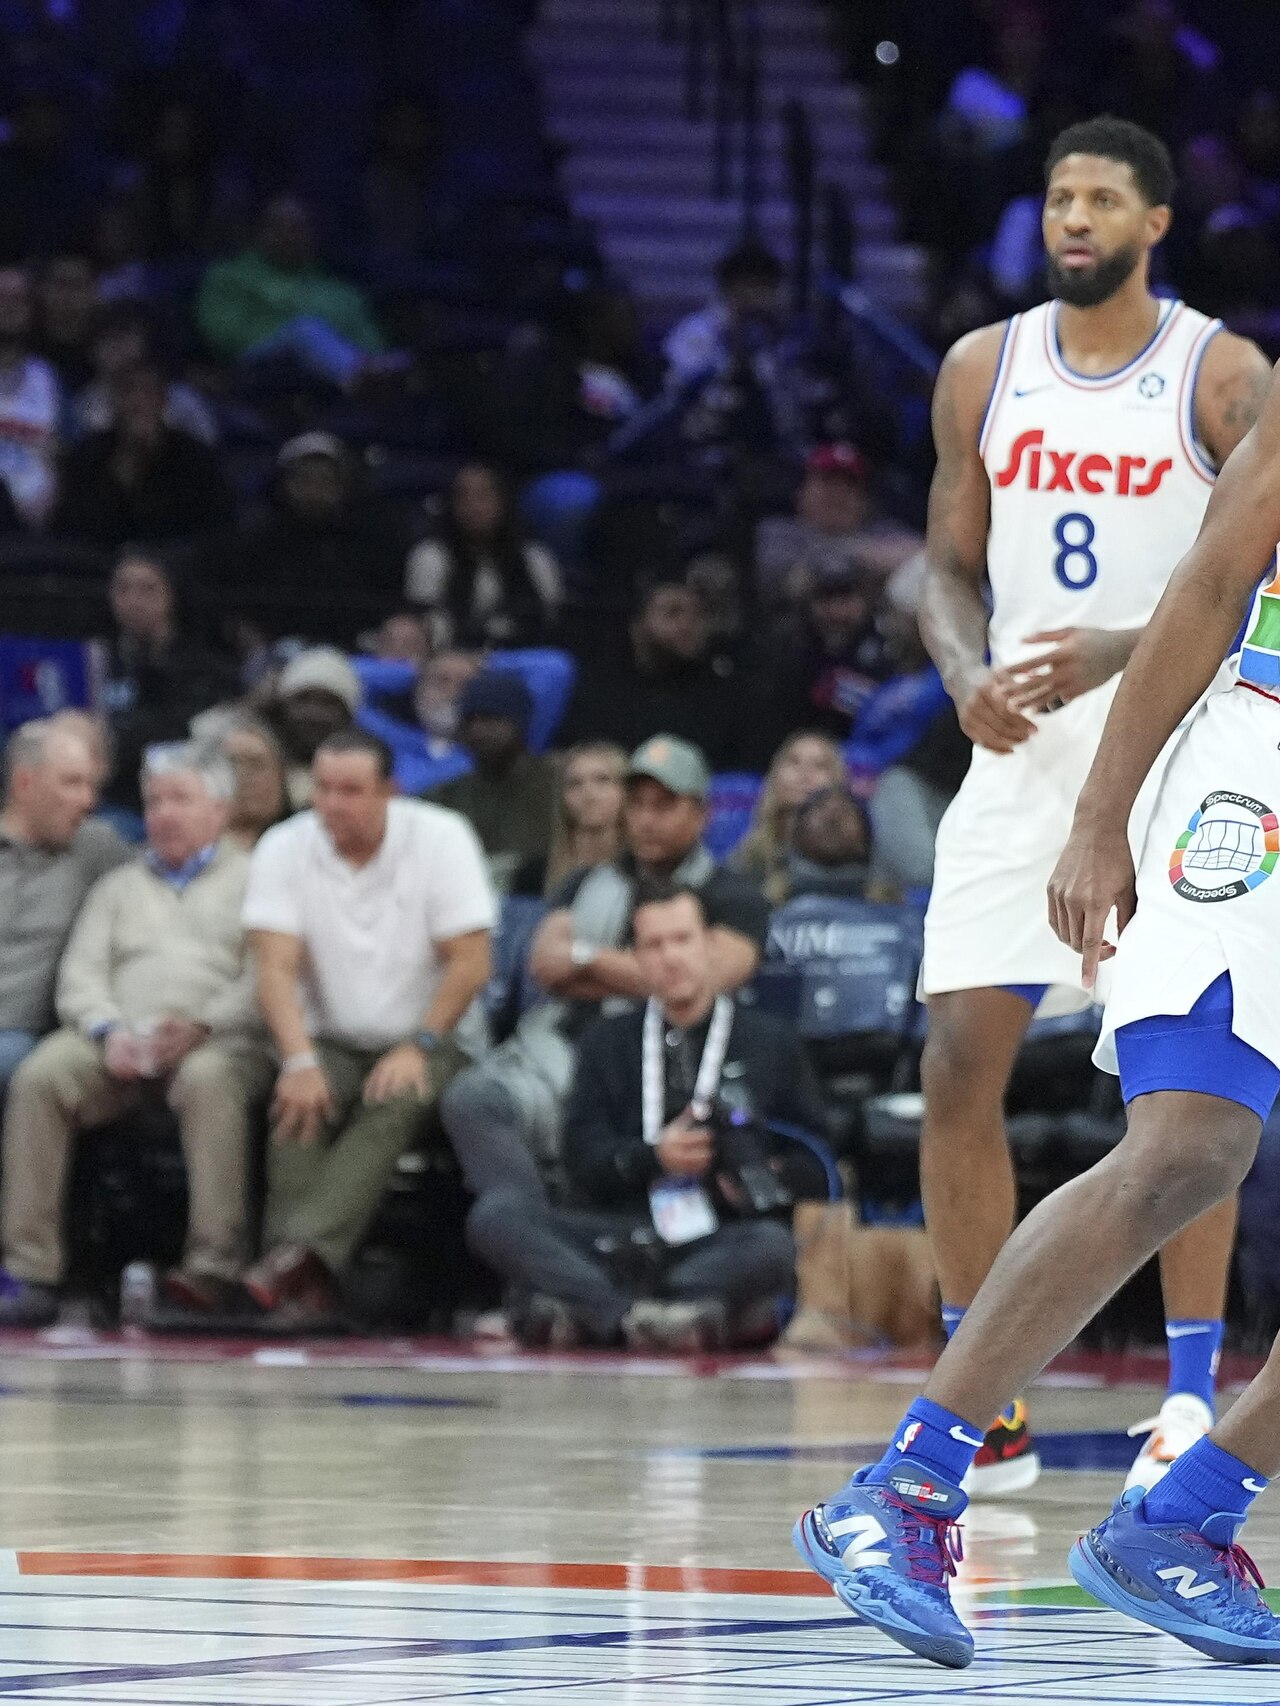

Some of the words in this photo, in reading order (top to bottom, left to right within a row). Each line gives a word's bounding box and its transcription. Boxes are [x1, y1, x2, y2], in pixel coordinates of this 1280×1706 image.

[994, 429, 1173, 498] Sixers
[1054, 512, 1098, 591] 8
[1205, 792, 1263, 813] Spectrum
[1179, 881, 1238, 900] Spectrum
